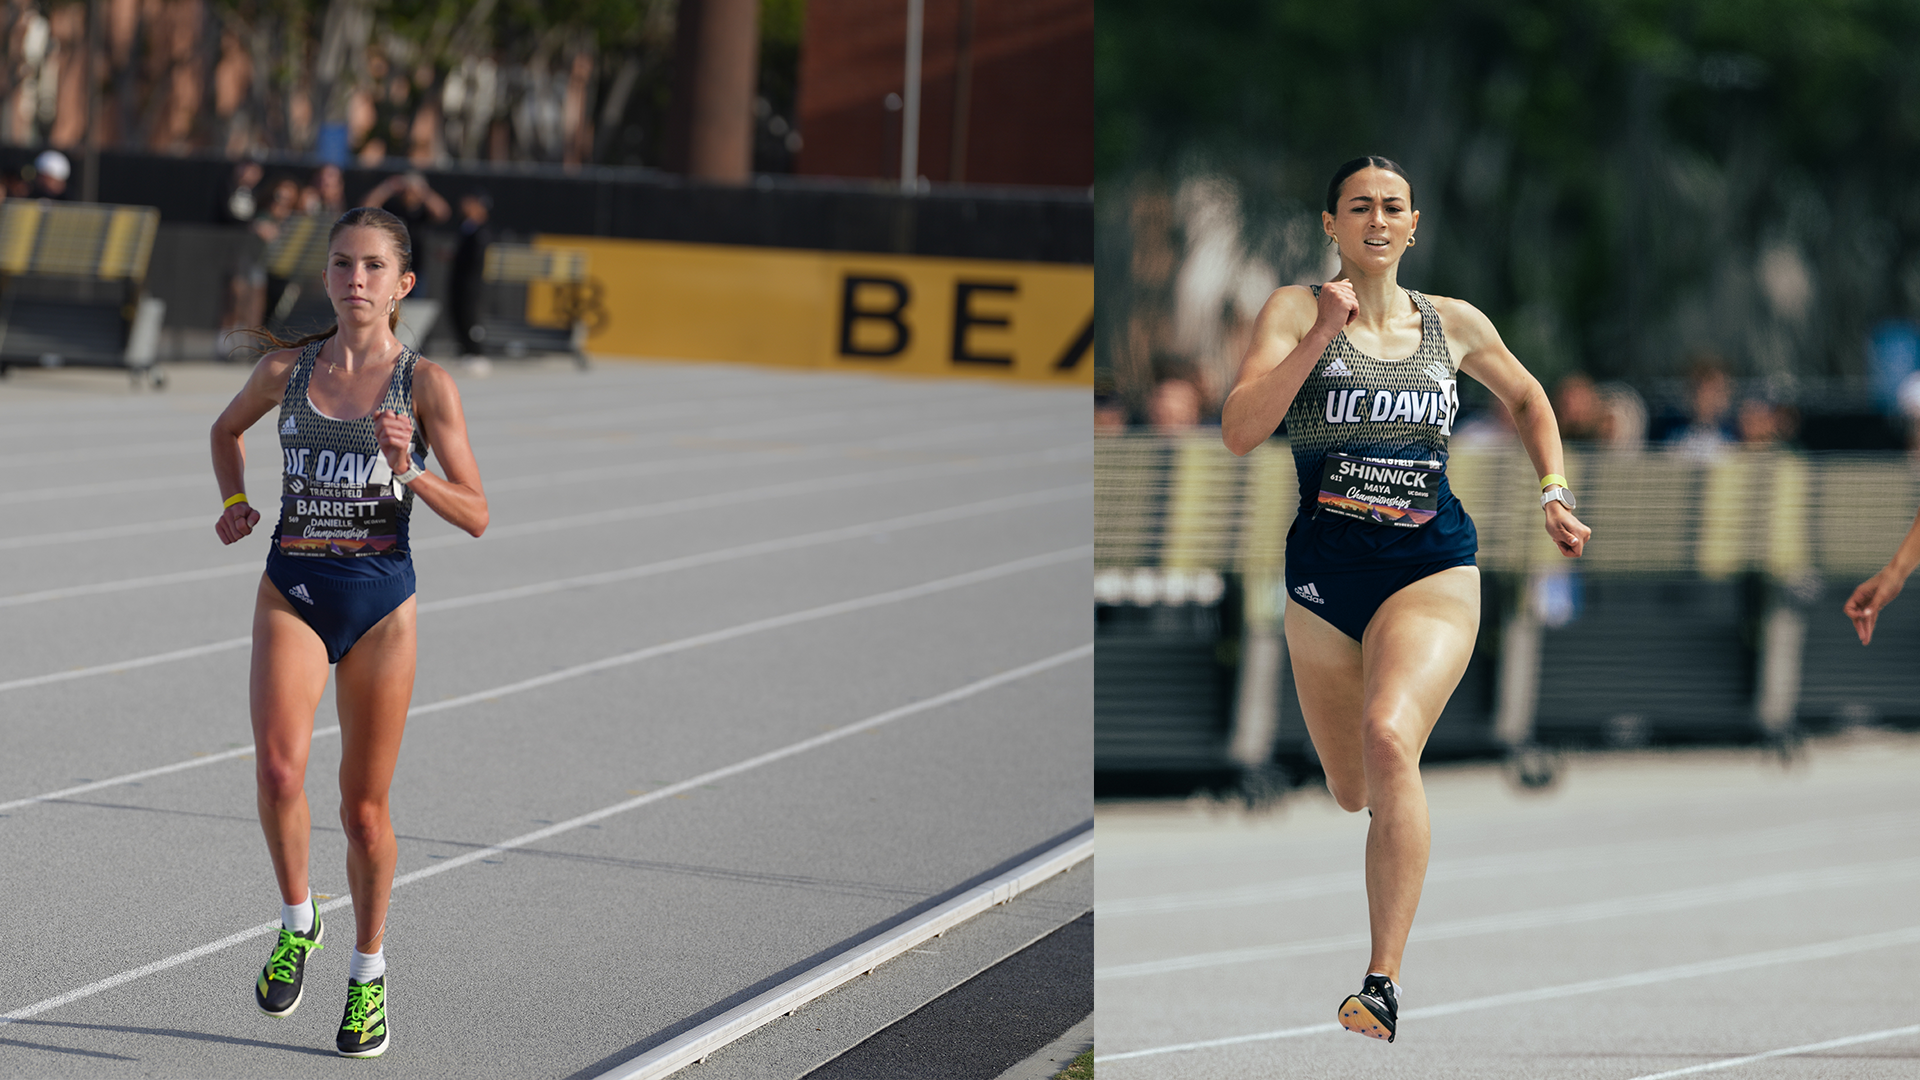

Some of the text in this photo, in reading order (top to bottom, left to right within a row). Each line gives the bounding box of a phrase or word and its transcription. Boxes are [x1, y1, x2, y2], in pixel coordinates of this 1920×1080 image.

[1321, 370, 1352, 378] adidas
[1325, 390, 1366, 423] UC
[284, 448, 377, 483] UC DAV
[1329, 474, 1343, 483] 611
[1338, 461, 1430, 489] SHINNICK
[310, 488, 363, 499] TRACK & FIELD
[1363, 483, 1391, 495] MAYA
[1345, 486, 1412, 510] Championships
[296, 500, 379, 517] BARRETT
[310, 518, 353, 527] DANIELLE
[302, 525, 370, 541] Championships
[1294, 587, 1324, 604] adidas
